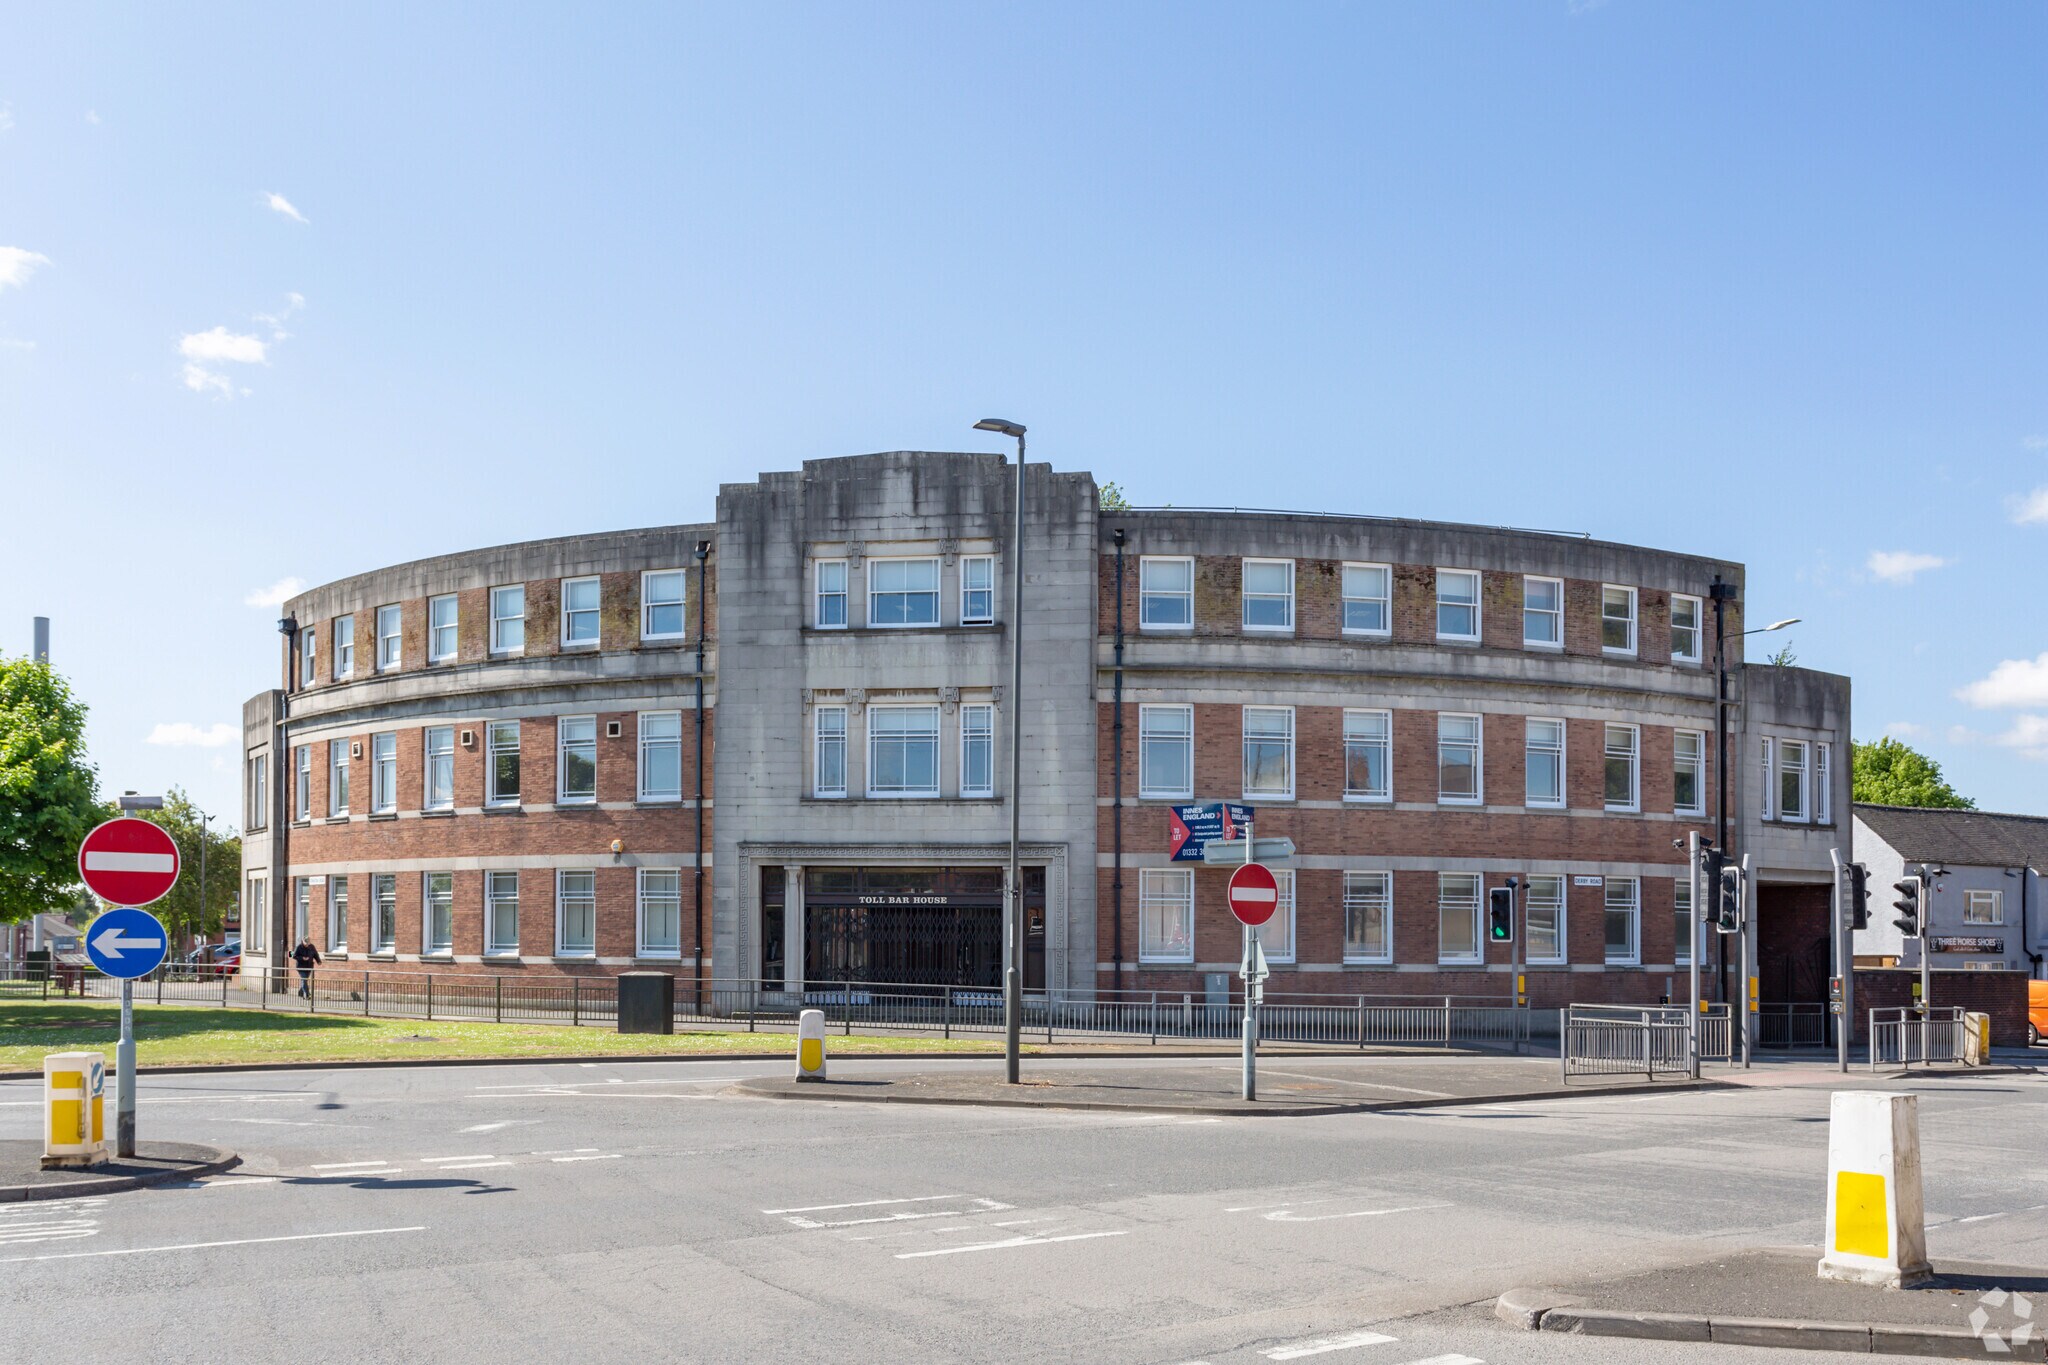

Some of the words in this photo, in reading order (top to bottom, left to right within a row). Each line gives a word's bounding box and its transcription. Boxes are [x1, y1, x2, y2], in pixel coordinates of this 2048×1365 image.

[1183, 812, 1215, 821] ENGLAND
[859, 896, 886, 904] TOLL
[888, 896, 910, 904] BAR
[913, 896, 948, 904] HOUSE
[1938, 937, 1957, 946] THREE
[1958, 937, 1977, 946] HORSE
[1977, 938, 1996, 946] SHOES
